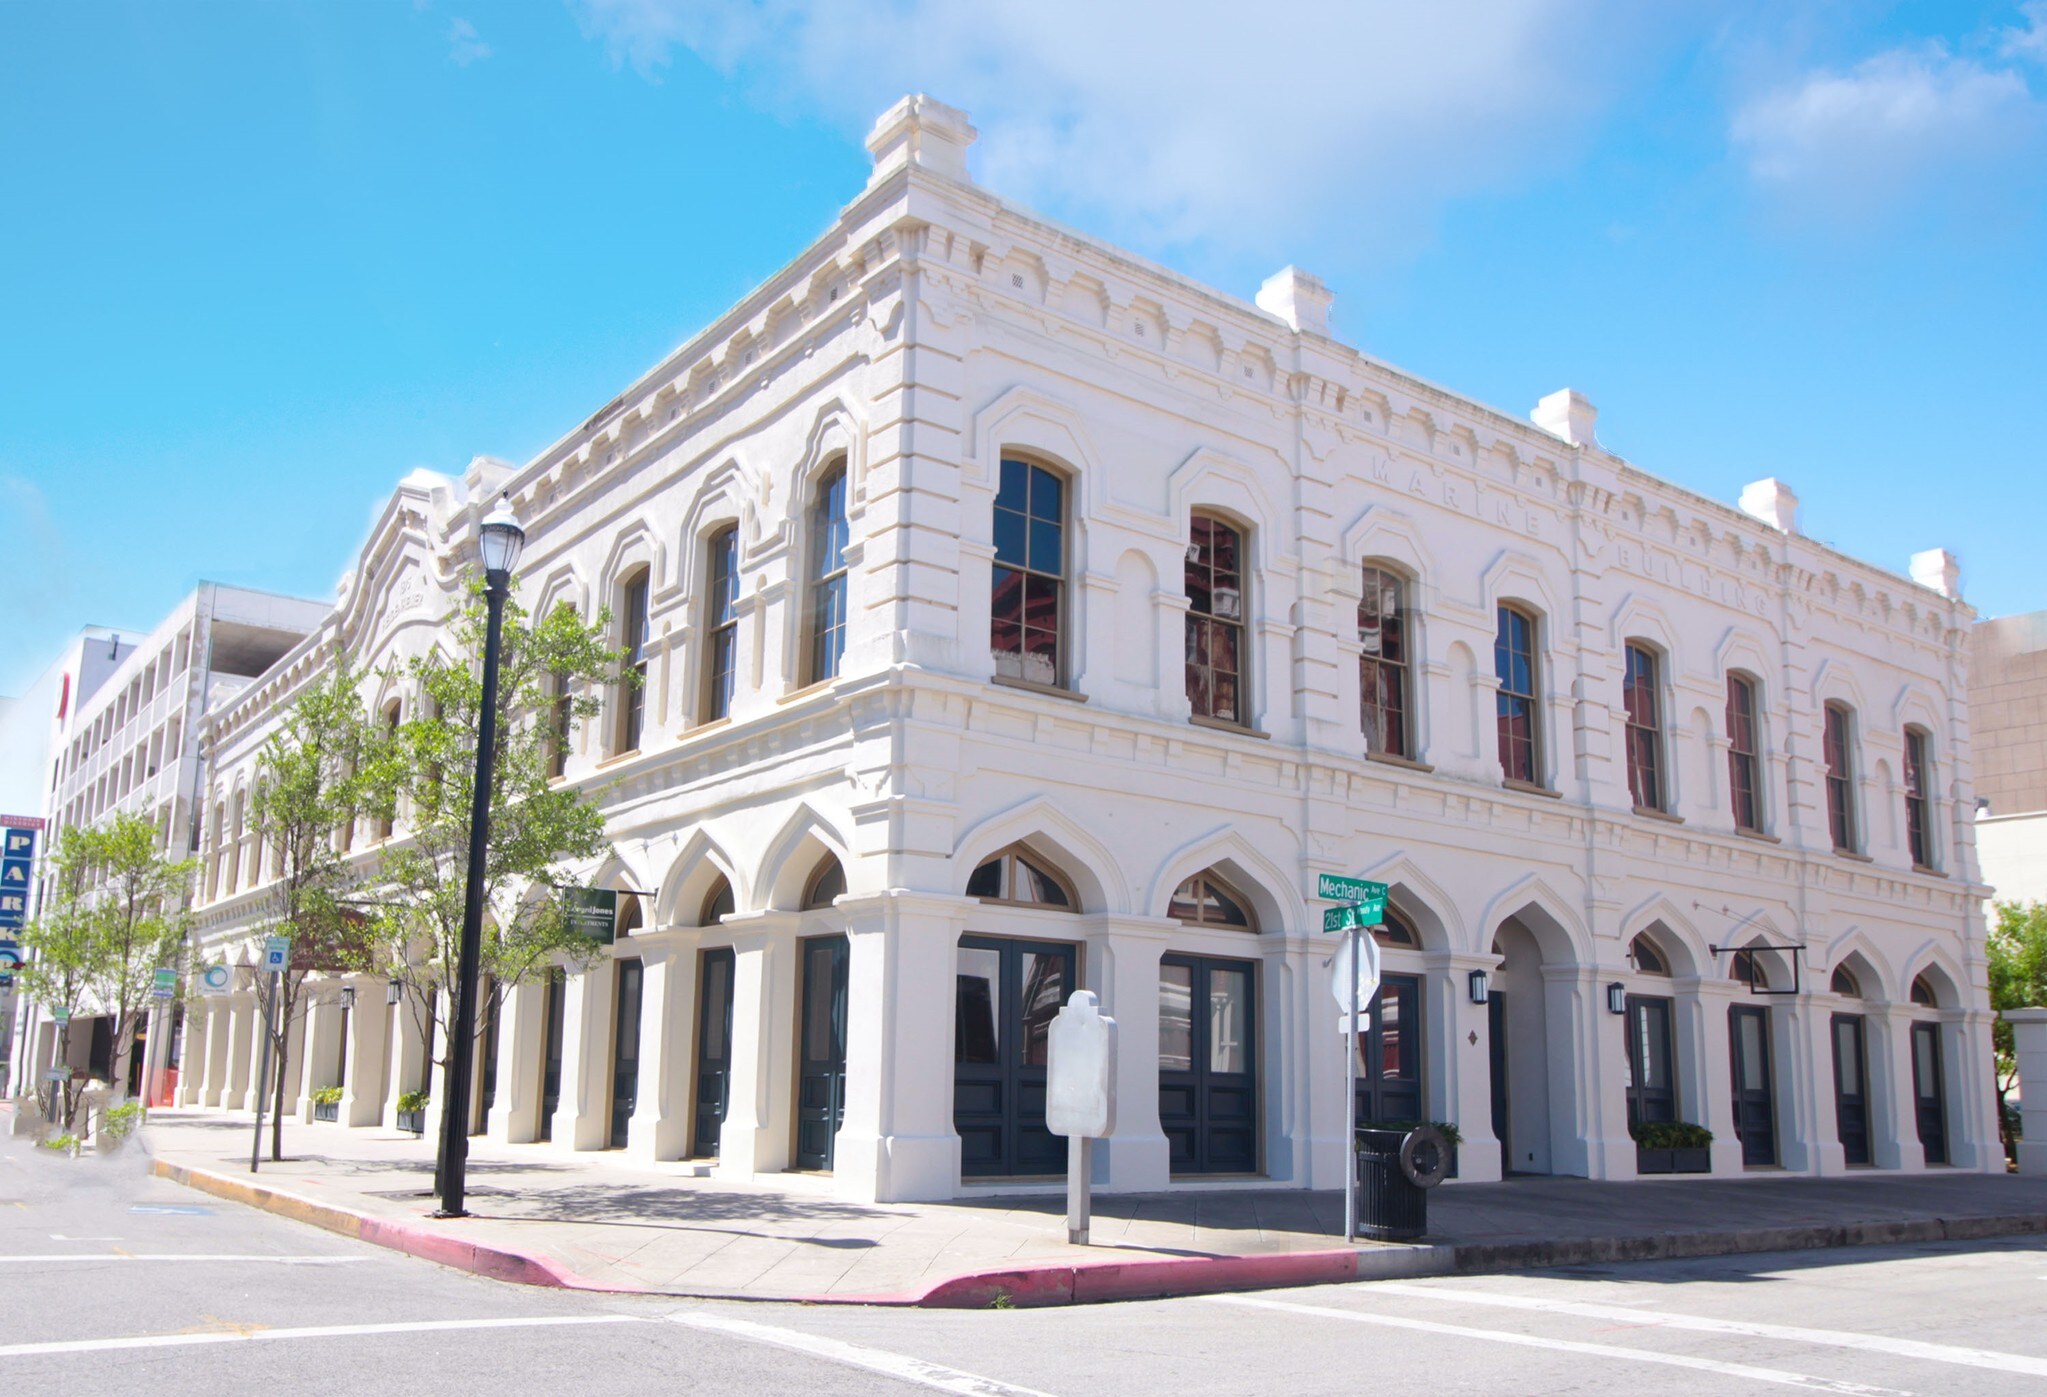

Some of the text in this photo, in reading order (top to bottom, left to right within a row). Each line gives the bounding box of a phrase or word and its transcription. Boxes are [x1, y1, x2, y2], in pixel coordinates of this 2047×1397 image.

[1372, 455, 1766, 616] MARINE BUILDING
[1320, 877, 1369, 901] Mechanic
[570, 919, 609, 928] INTMENTS
[1325, 908, 1356, 929] 21st St
